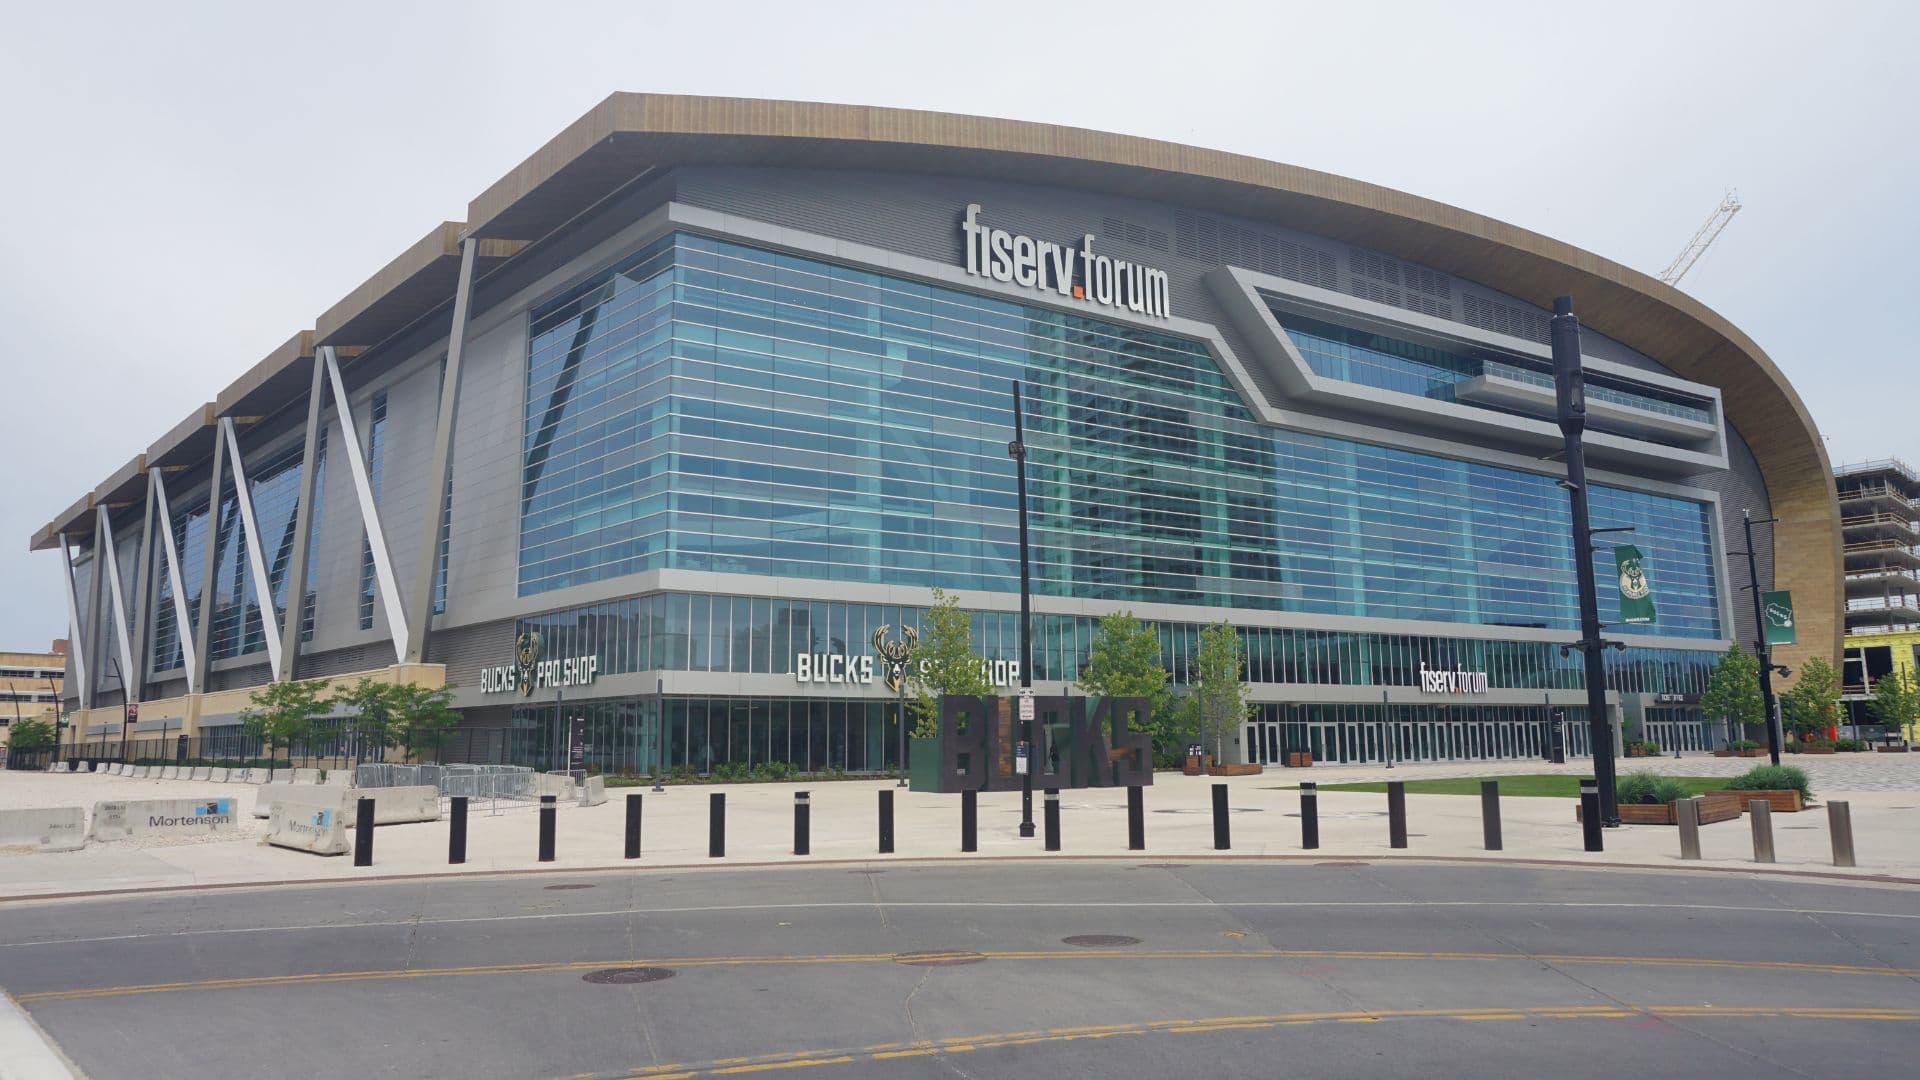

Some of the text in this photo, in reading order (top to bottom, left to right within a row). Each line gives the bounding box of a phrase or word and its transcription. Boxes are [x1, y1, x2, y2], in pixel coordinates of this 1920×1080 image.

[481, 655, 597, 693] BUCKS PRO SHOP
[797, 653, 873, 683] BUCKS
[149, 815, 229, 827] Mortenson
